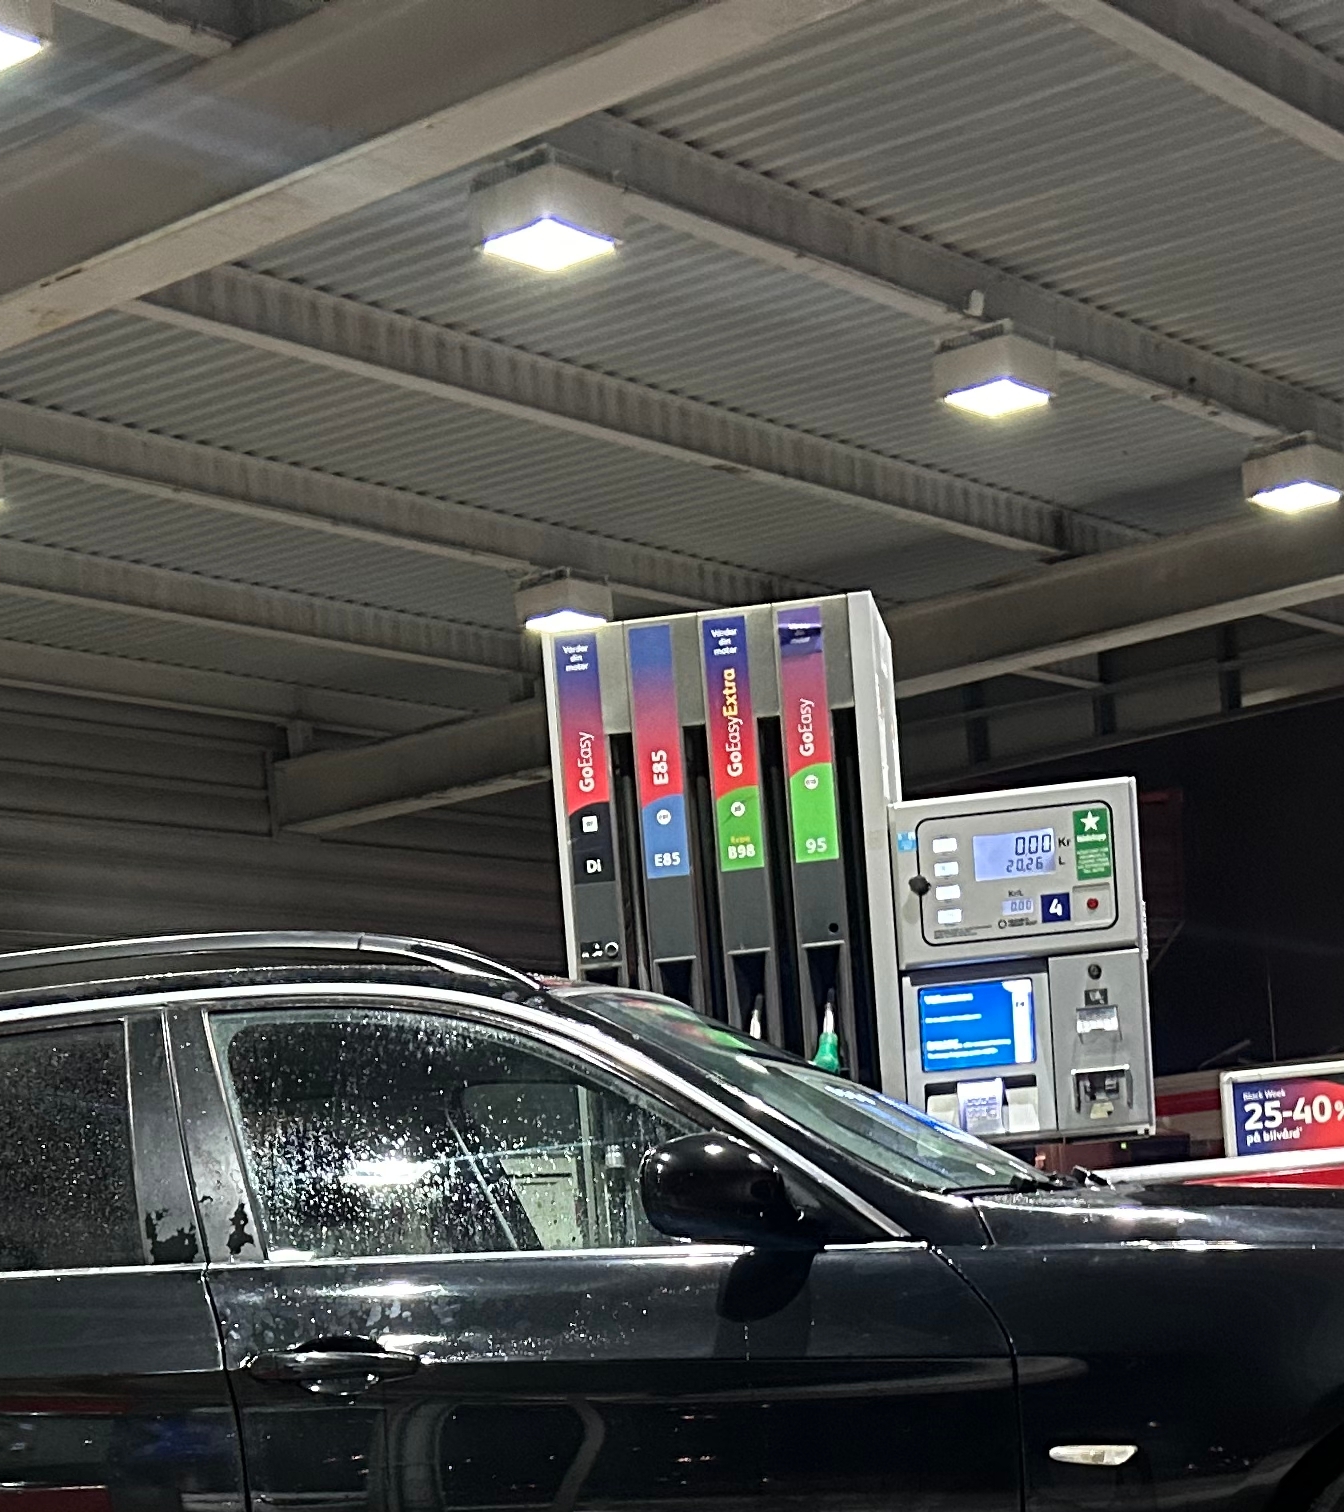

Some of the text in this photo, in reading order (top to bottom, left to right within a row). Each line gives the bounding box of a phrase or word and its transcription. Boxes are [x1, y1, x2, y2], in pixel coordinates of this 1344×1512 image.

[798, 698, 815, 757] GoEasy
[577, 731, 595, 792] GoEasy
[651, 750, 669, 785] E85
[805, 837, 827, 854] 95
[1058, 837, 1071, 848] Kr
[654, 852, 681, 867] E85
[728, 843, 755, 860] B98
[586, 859, 602, 874] Di
[1058, 856, 1066, 866] L
[1049, 898, 1063, 916] 4
[1246, 1131, 1262, 1147] på
